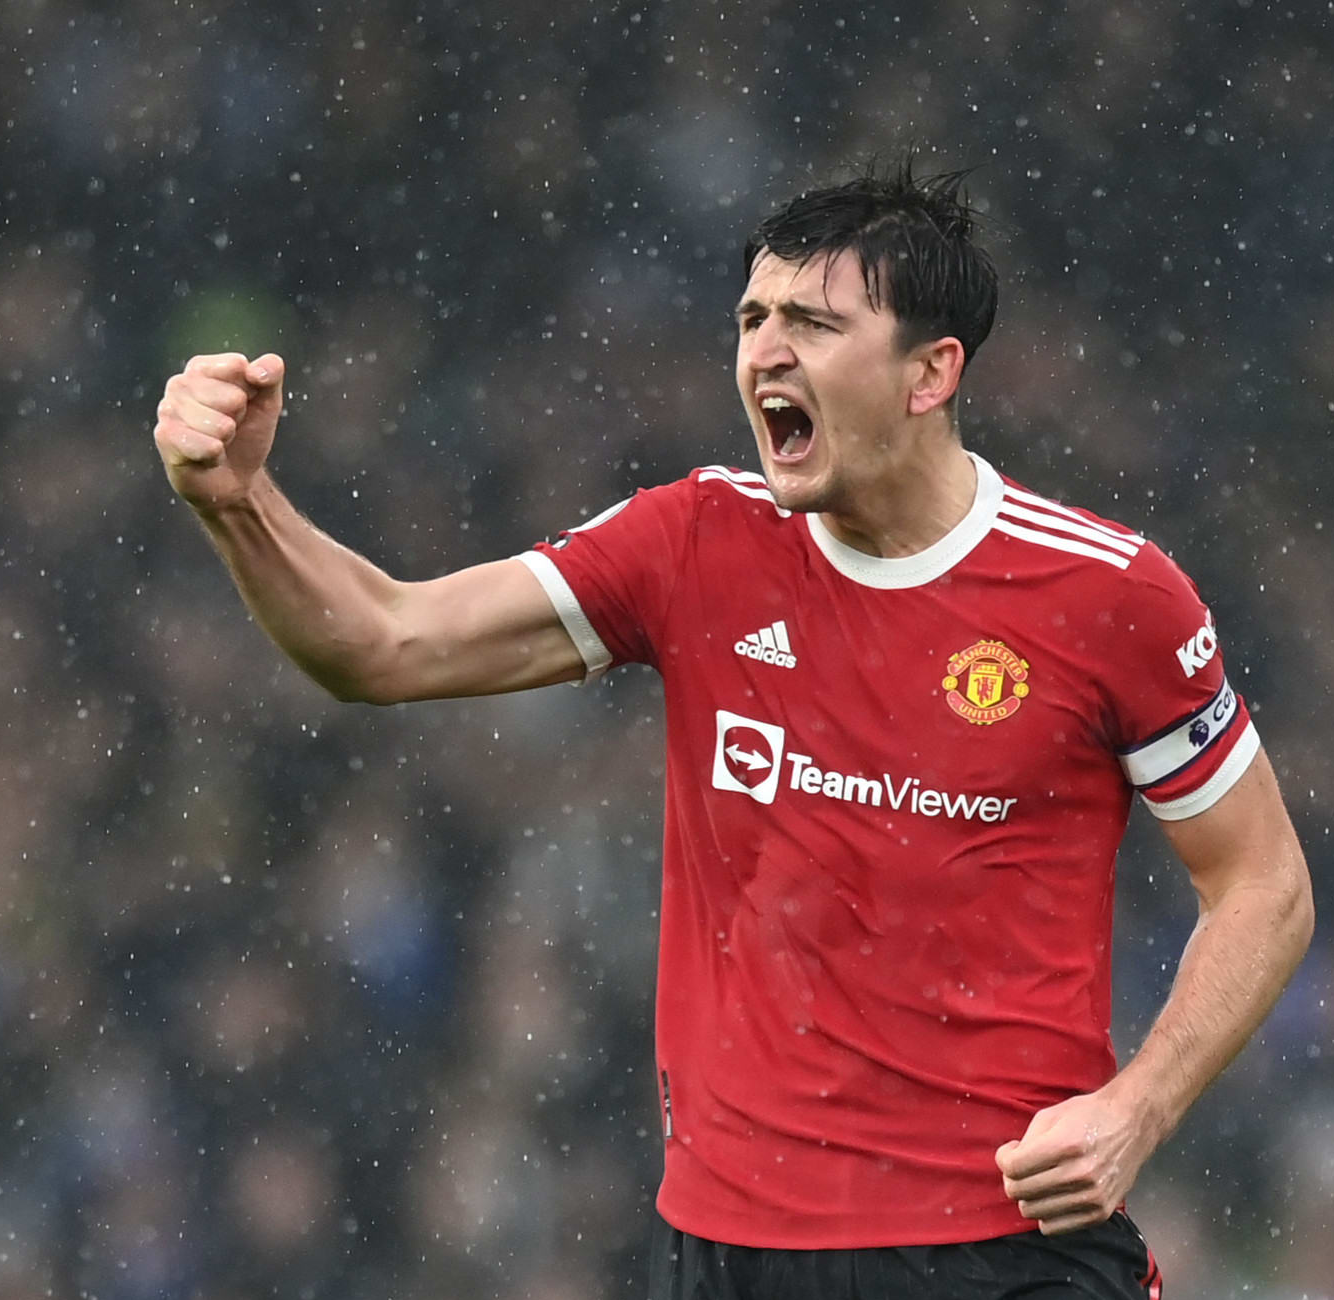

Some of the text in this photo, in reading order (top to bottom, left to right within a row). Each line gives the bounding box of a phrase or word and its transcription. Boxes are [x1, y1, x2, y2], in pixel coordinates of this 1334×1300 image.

[734, 640, 797, 669] adidas
[954, 646, 1023, 677] MANCHESTER
[959, 703, 1007, 719] UNITED
[786, 752, 1017, 822] TeamViewer
